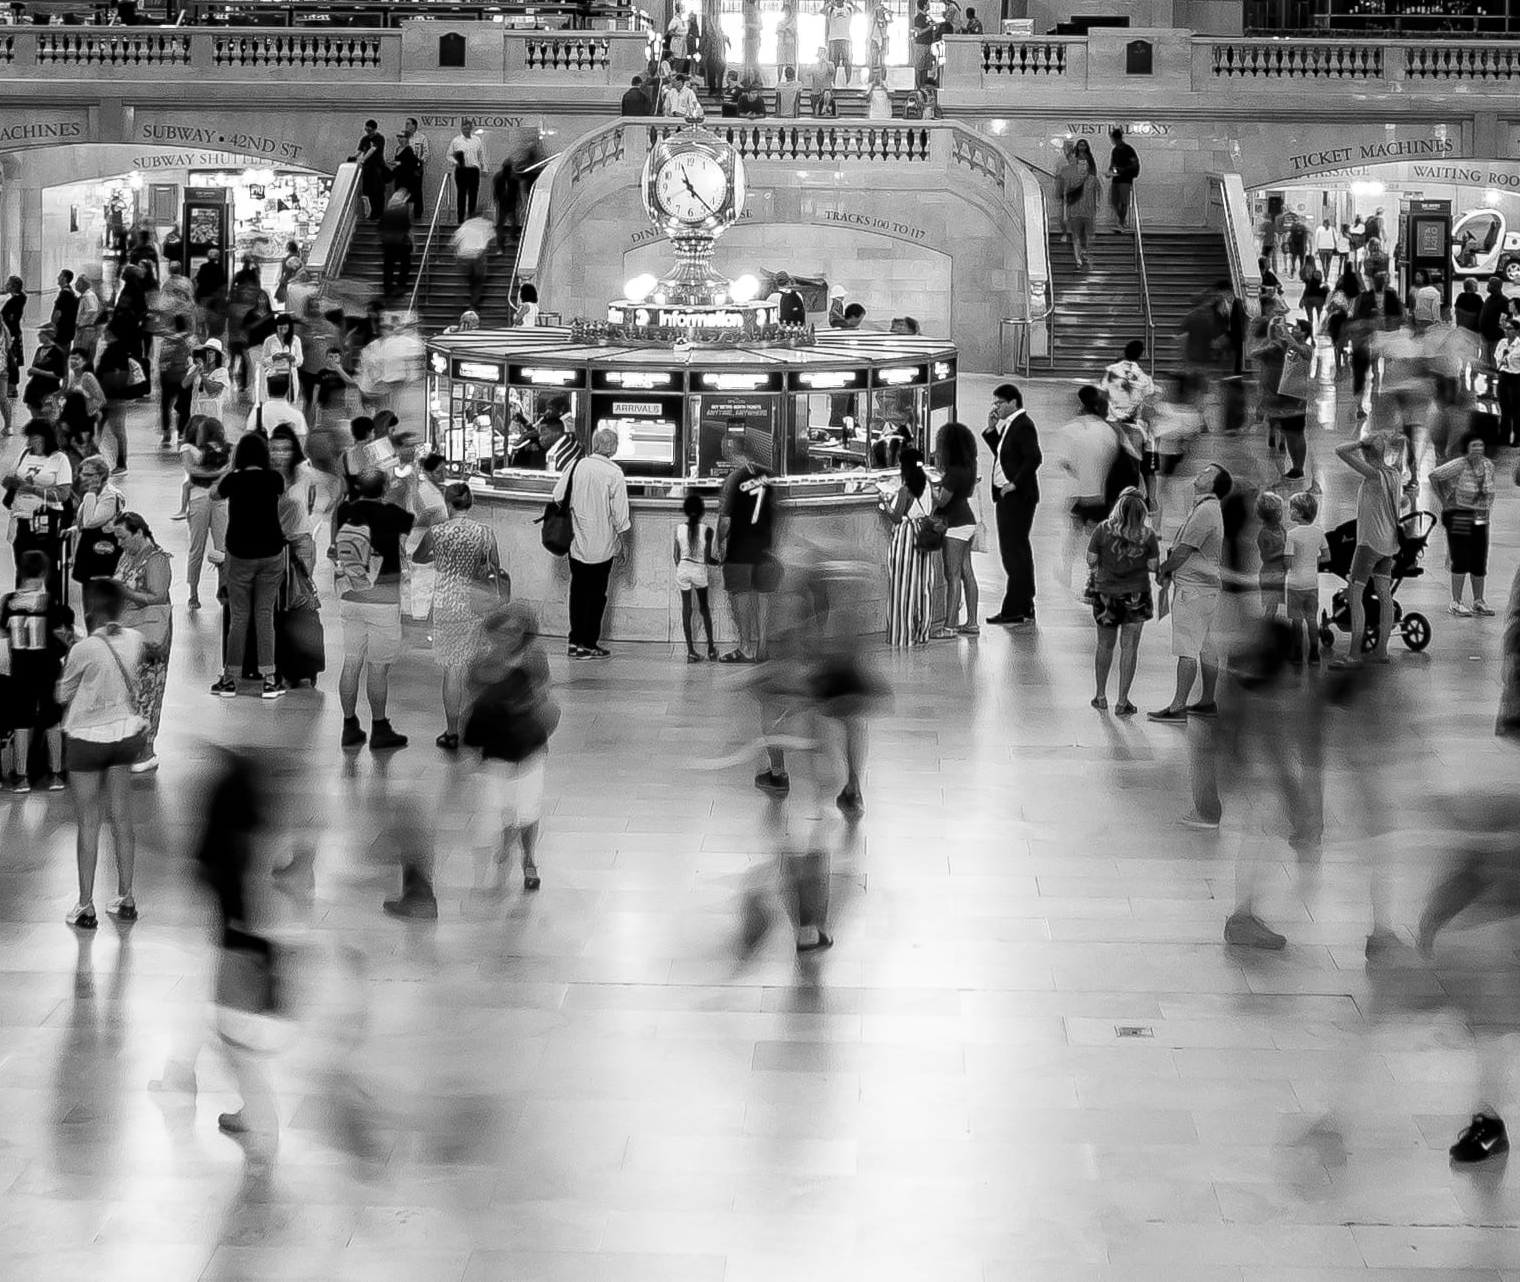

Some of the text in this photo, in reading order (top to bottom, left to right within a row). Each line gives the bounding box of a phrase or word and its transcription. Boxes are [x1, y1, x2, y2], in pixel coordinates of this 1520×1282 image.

[421, 116, 455, 127] WEST
[1068, 123, 1172, 135] WEST LONY
[143, 124, 303, 159] SUBWAY 42ND ST
[132, 154, 195, 169] SUBWAY
[1289, 138, 1454, 170] TICKET MACHINES
[1413, 165, 1482, 182] WAITING
[825, 210, 926, 238] TRACKS 100 TO 117
[631, 226, 659, 242] DINI
[659, 310, 744, 327] Information
[615, 404, 660, 414] ARRIVALS
[749, 485, 766, 524] 7
